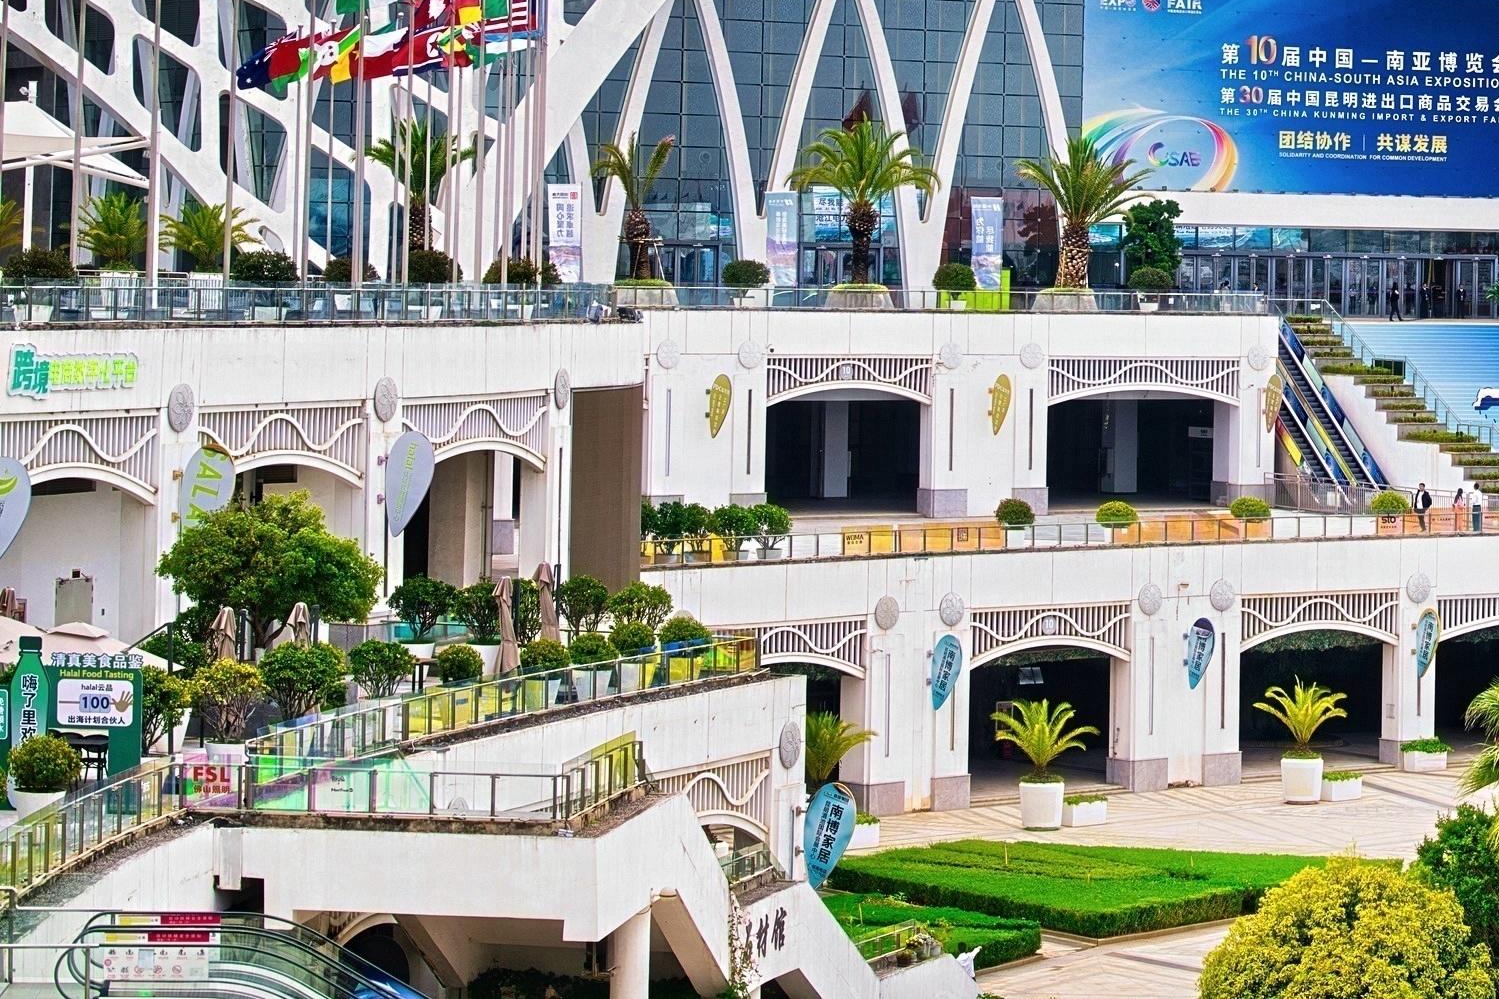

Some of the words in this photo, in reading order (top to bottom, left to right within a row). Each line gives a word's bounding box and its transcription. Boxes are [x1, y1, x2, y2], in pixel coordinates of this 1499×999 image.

[1220, 69, 1247, 81] THE
[1253, 70, 1279, 81] 10TH
[1284, 71, 1381, 86] CHINA-SOUTH
[1386, 75, 1419, 87] ASIA
[1220, 108, 1240, 116] THE
[1246, 109, 1268, 117] 30TH
[1273, 110, 1308, 118] CHINA
[1313, 111, 1367, 120] KUNMING
[1372, 113, 1415, 122] IMPORT
[1420, 114, 1427, 122] &
[1433, 115, 1478, 124] EXPORT
[1279, 130, 1351, 151] 团结协作
[1377, 133, 1448, 154] 共谋发展
[51, 652, 143, 669] 清真美食品鉴
[60, 669, 80, 677] Halal
[82, 670, 103, 679] Food
[105, 671, 134, 680] Tasting
[81, 696, 110, 710] 100
[67, 715, 126, 725] 出海计划合伙人
[193, 766, 230, 783] FSL
[817, 803, 845, 865] 南博家居
